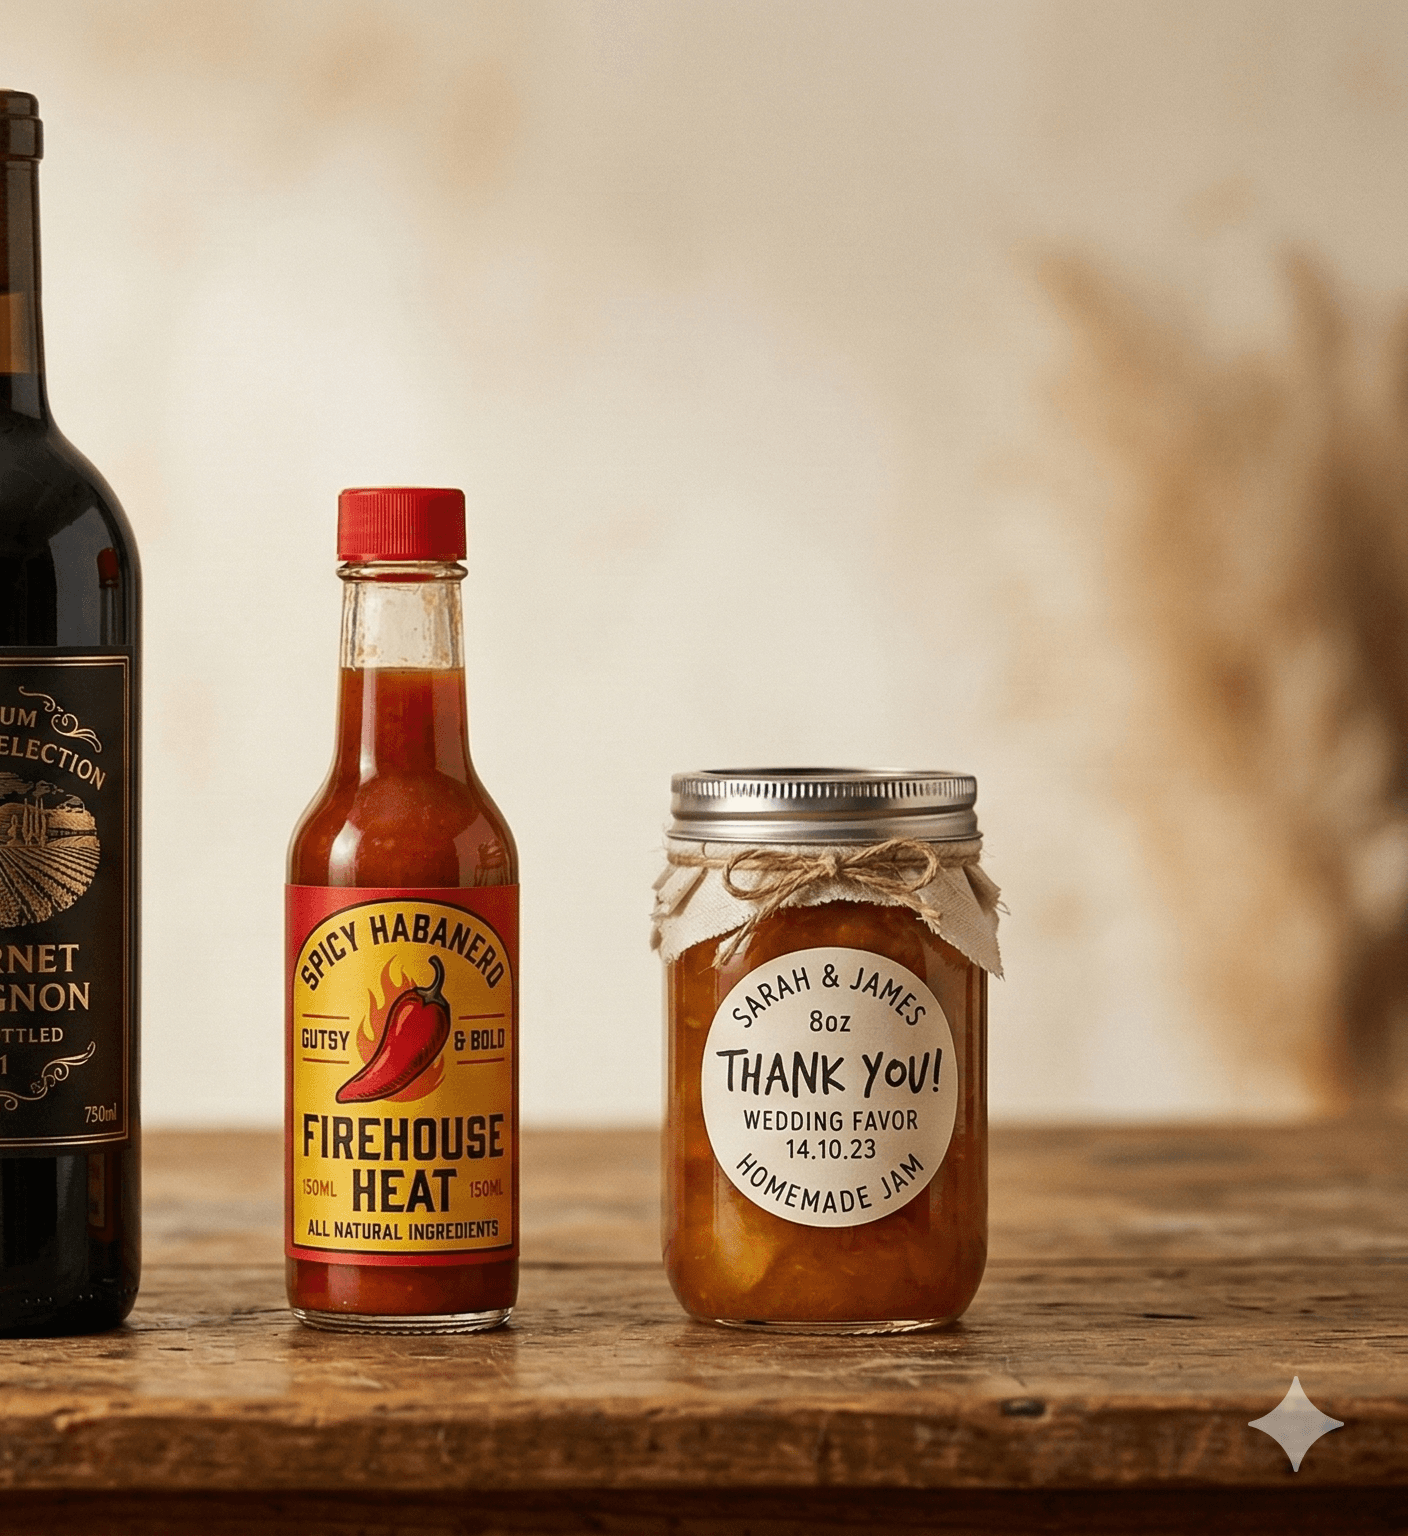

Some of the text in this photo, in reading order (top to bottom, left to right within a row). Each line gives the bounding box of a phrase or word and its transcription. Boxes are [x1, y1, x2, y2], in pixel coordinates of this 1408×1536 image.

[301, 913, 504, 991] SPICY HABANERO
[732, 963, 926, 1028] SARAH & JAMES
[809, 1010, 851, 1032] 8oz
[302, 1028, 505, 1051] GUTSY & BOLD
[716, 1048, 942, 1098] THANK YOU!
[743, 1110, 918, 1132] WEDDING FAVOR
[303, 1113, 504, 1161] FIREHOUSE
[786, 1138, 876, 1160] 14.10.23
[303, 1179, 337, 1197] 150ML
[352, 1169, 457, 1212] HEAT
[470, 1179, 503, 1198] 150ML
[736, 1152, 925, 1213] HOMEMADE JAM
[307, 1219, 498, 1240] ALL NATURAL INGREDIENTS
